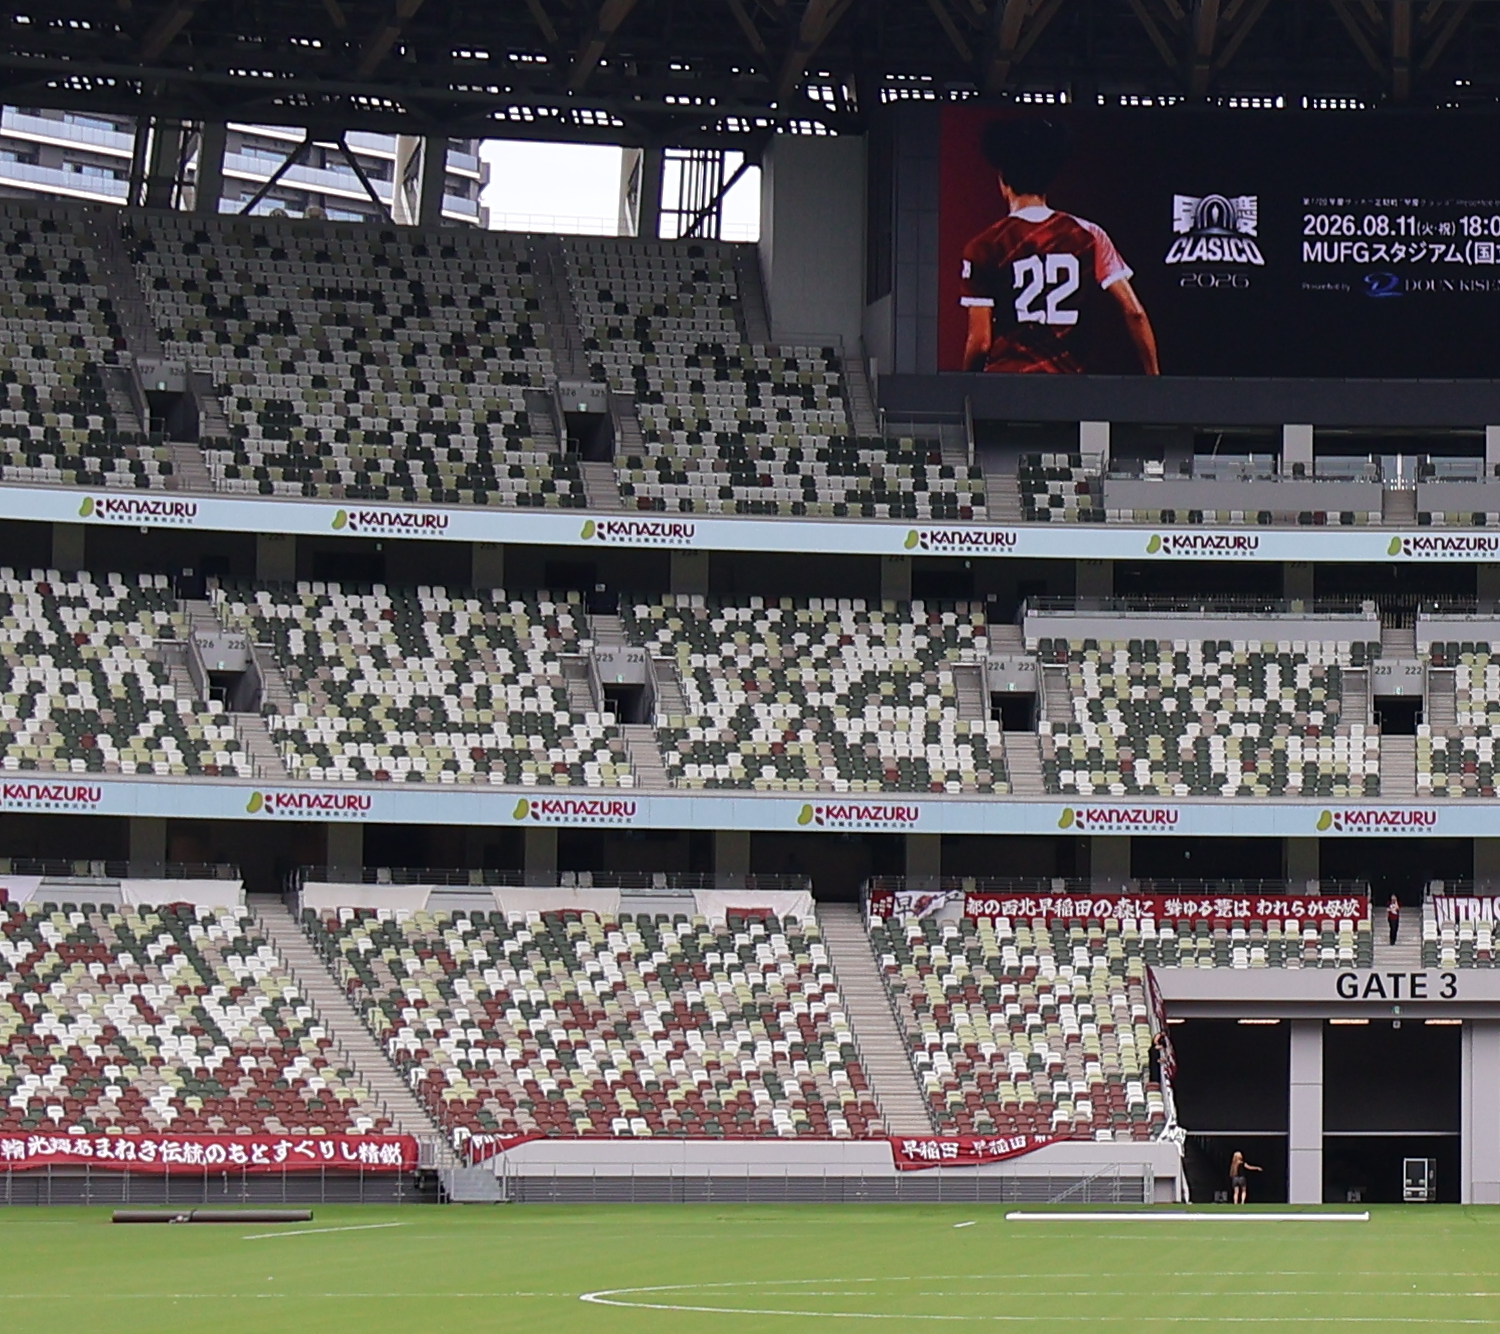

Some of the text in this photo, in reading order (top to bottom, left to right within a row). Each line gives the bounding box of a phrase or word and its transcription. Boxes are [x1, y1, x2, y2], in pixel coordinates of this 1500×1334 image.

[1165, 237, 1266, 266] CLASICO
[1013, 253, 1080, 325] 22
[1180, 273, 1250, 288] 2026
[105, 499, 197, 517] KANAZURU
[358, 510, 448, 529] KANAZURU
[606, 520, 695, 539] KANAZURU
[929, 529, 1017, 548] KANAZURU
[1172, 535, 1259, 550] KANAZURU
[1413, 535, 1499, 550] KANAZURU
[228, 641, 246, 650] 225
[596, 653, 613, 662] 225
[627, 654, 644, 663] 224
[988, 662, 1005, 671] 224
[1018, 662, 1036, 671] 223
[1374, 666, 1392, 675] 223
[1405, 666, 1422, 675] 222
[3, 784, 101, 802] KANAZURU
[276, 793, 371, 811] KANAZURU
[542, 800, 636, 817] KANAZURU
[826, 805, 918, 822] KANAZURU
[1087, 809, 1178, 825] KANAZURU
[1345, 811, 1436, 826] KANAZURU
[966, 897, 1154, 919] 都の西北早稲田の森に
[1256, 898, 1360, 917] われらが母校
[1336, 973, 1458, 999] GATE 3
[901, 1139, 959, 1159] 早稲田
